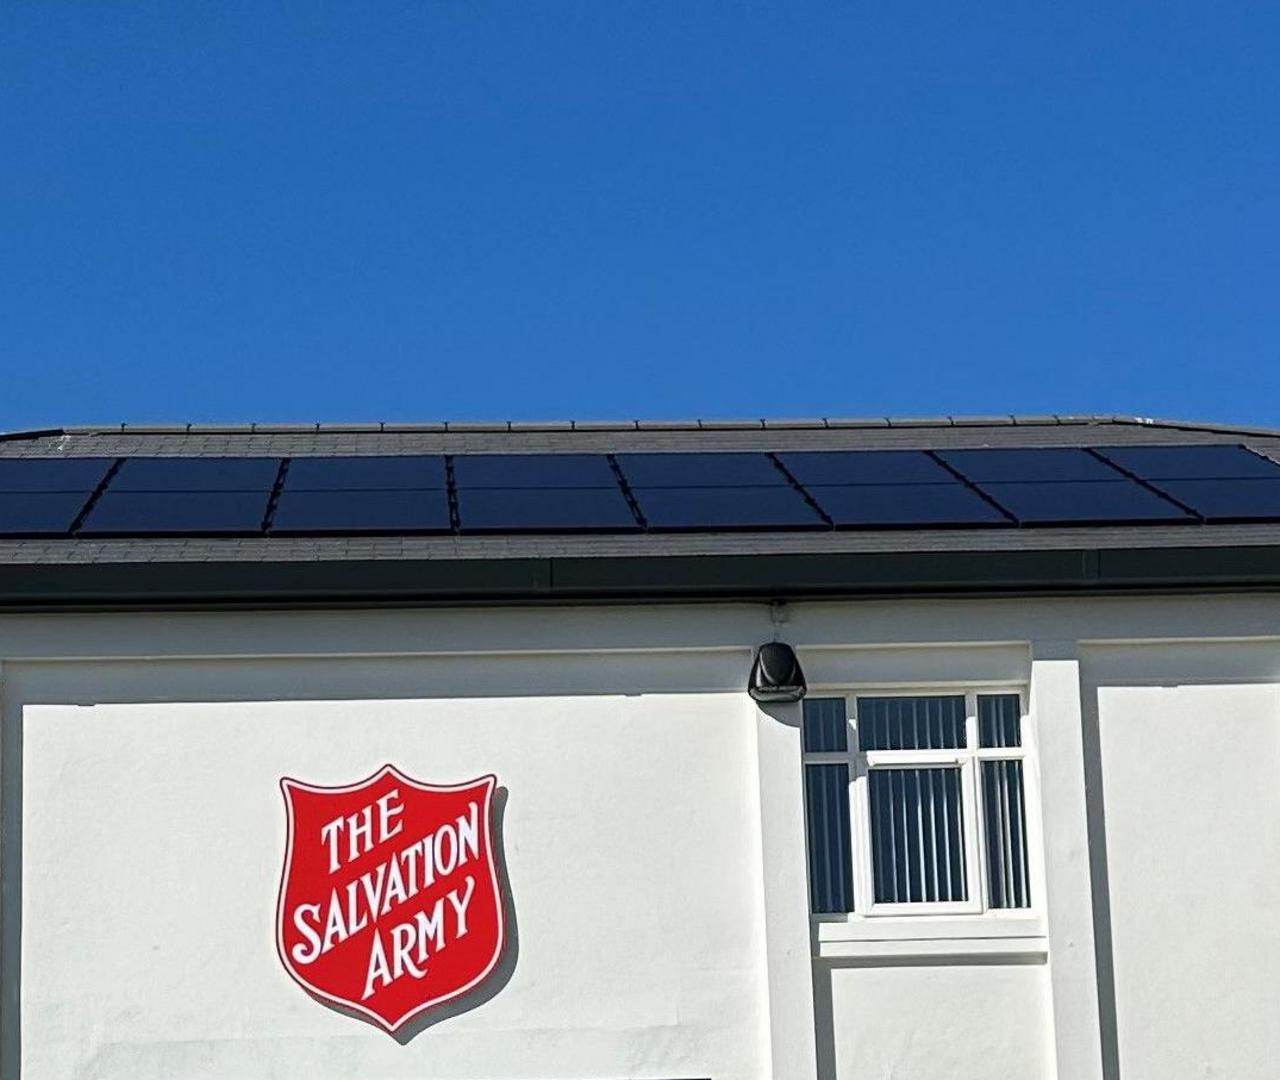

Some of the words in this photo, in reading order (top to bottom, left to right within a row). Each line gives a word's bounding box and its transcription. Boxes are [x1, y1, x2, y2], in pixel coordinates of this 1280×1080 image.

[292, 801, 479, 964] SALVATION
[321, 789, 404, 874] THE
[360, 876, 475, 1000] ARMY
